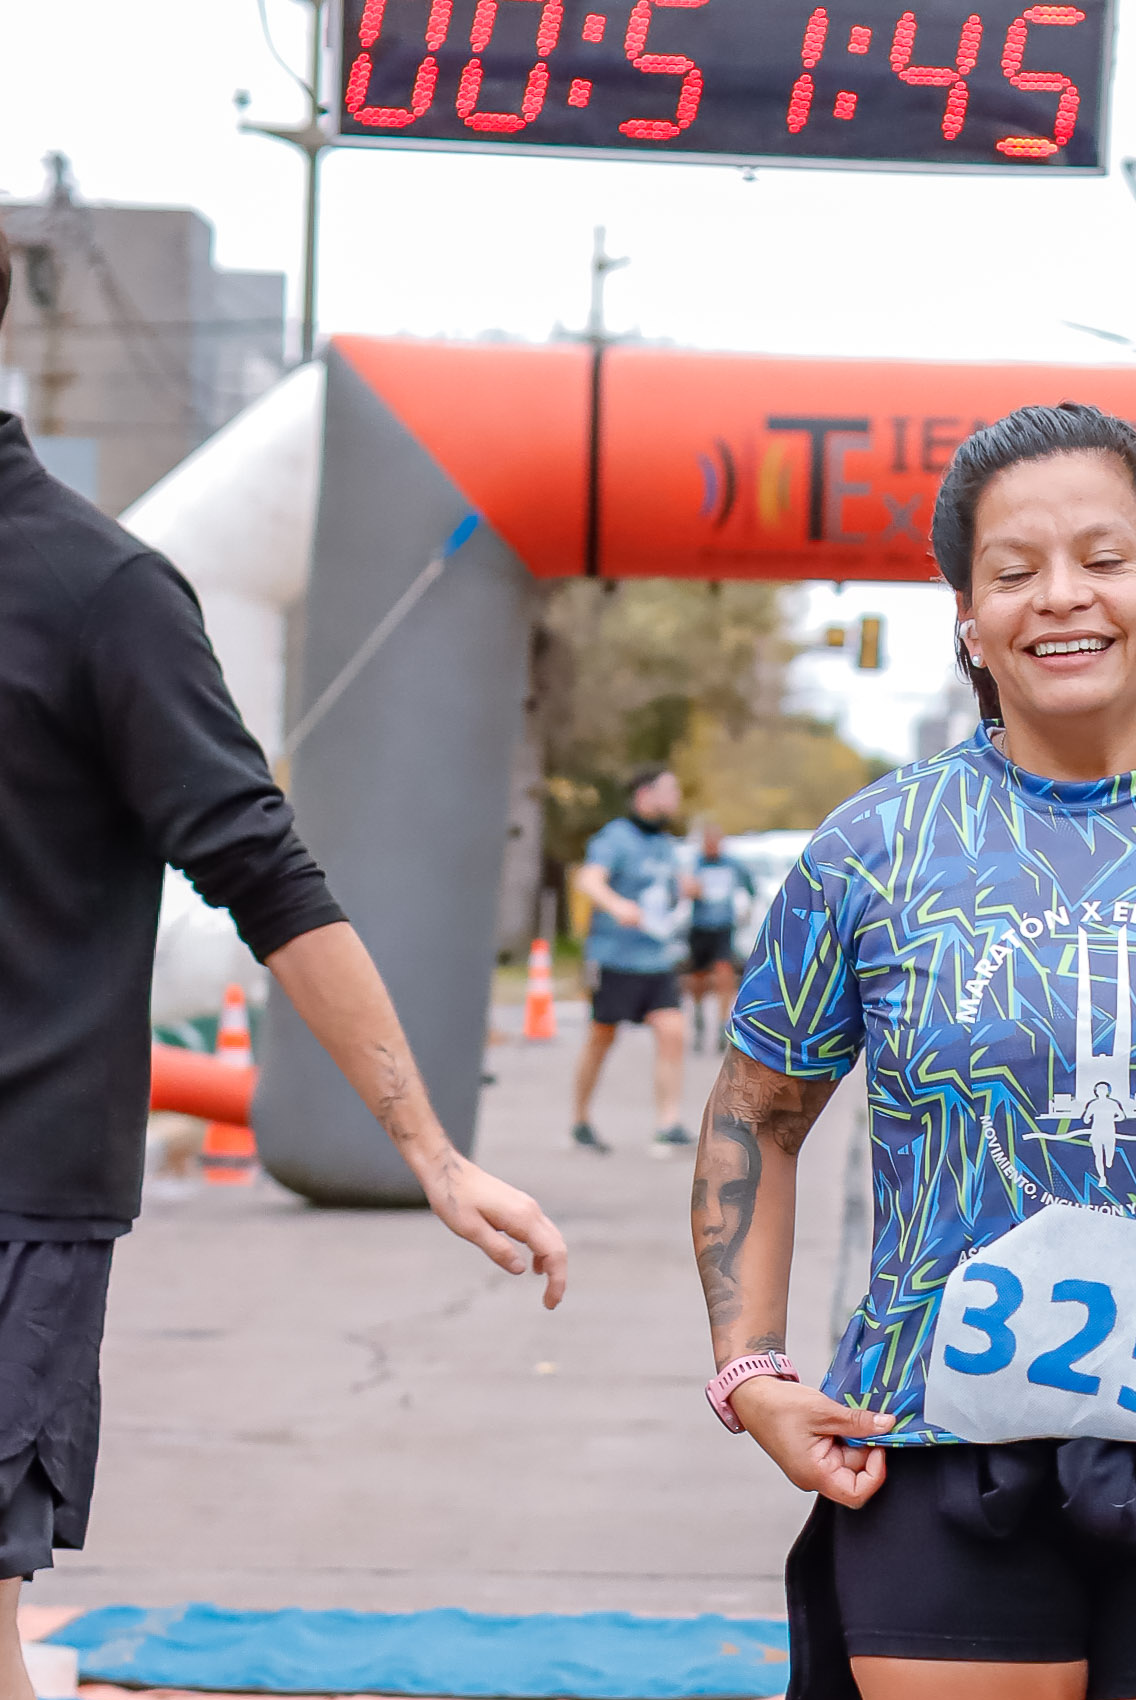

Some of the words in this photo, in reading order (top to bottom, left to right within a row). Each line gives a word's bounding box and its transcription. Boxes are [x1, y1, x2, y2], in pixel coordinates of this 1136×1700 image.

[766, 415, 988, 542] TIE
[955, 905, 1070, 1024] MARATÓN
[1080, 900, 1103, 922] X
[979, 1114, 1038, 1200] MOVIMIENTO,
[1125, 1202, 1136, 1215] Y
